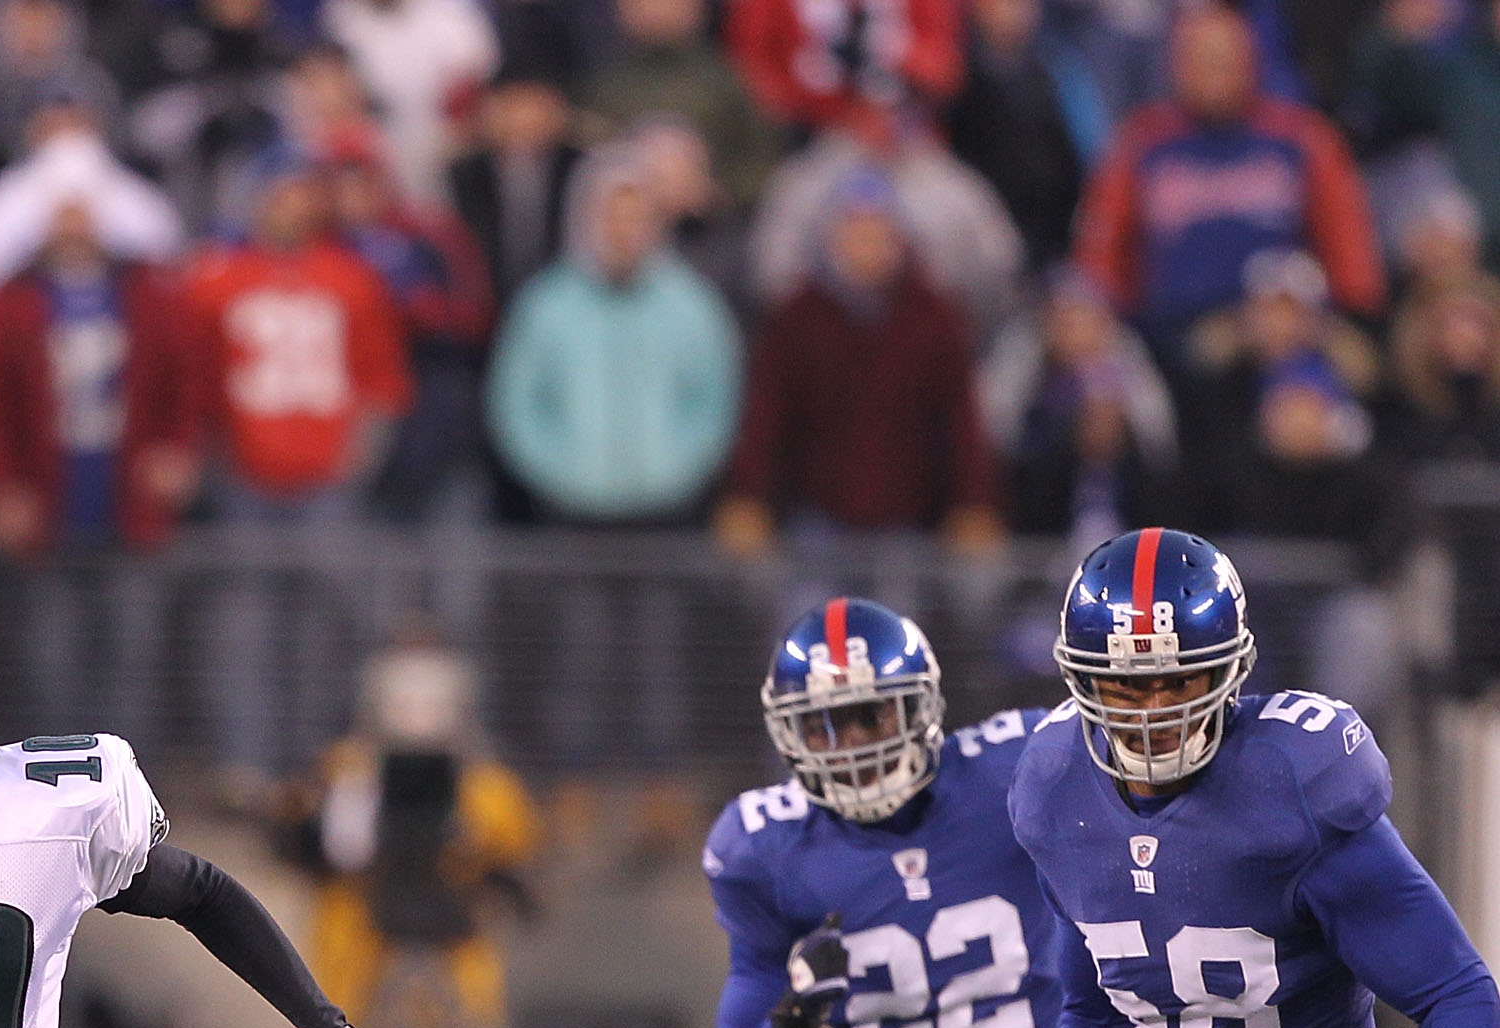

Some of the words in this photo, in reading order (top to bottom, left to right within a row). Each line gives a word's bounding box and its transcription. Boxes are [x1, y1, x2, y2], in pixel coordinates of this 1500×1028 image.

[1112, 601, 1174, 634] 58
[1258, 689, 1352, 732] 5
[25, 734, 102, 787] 10
